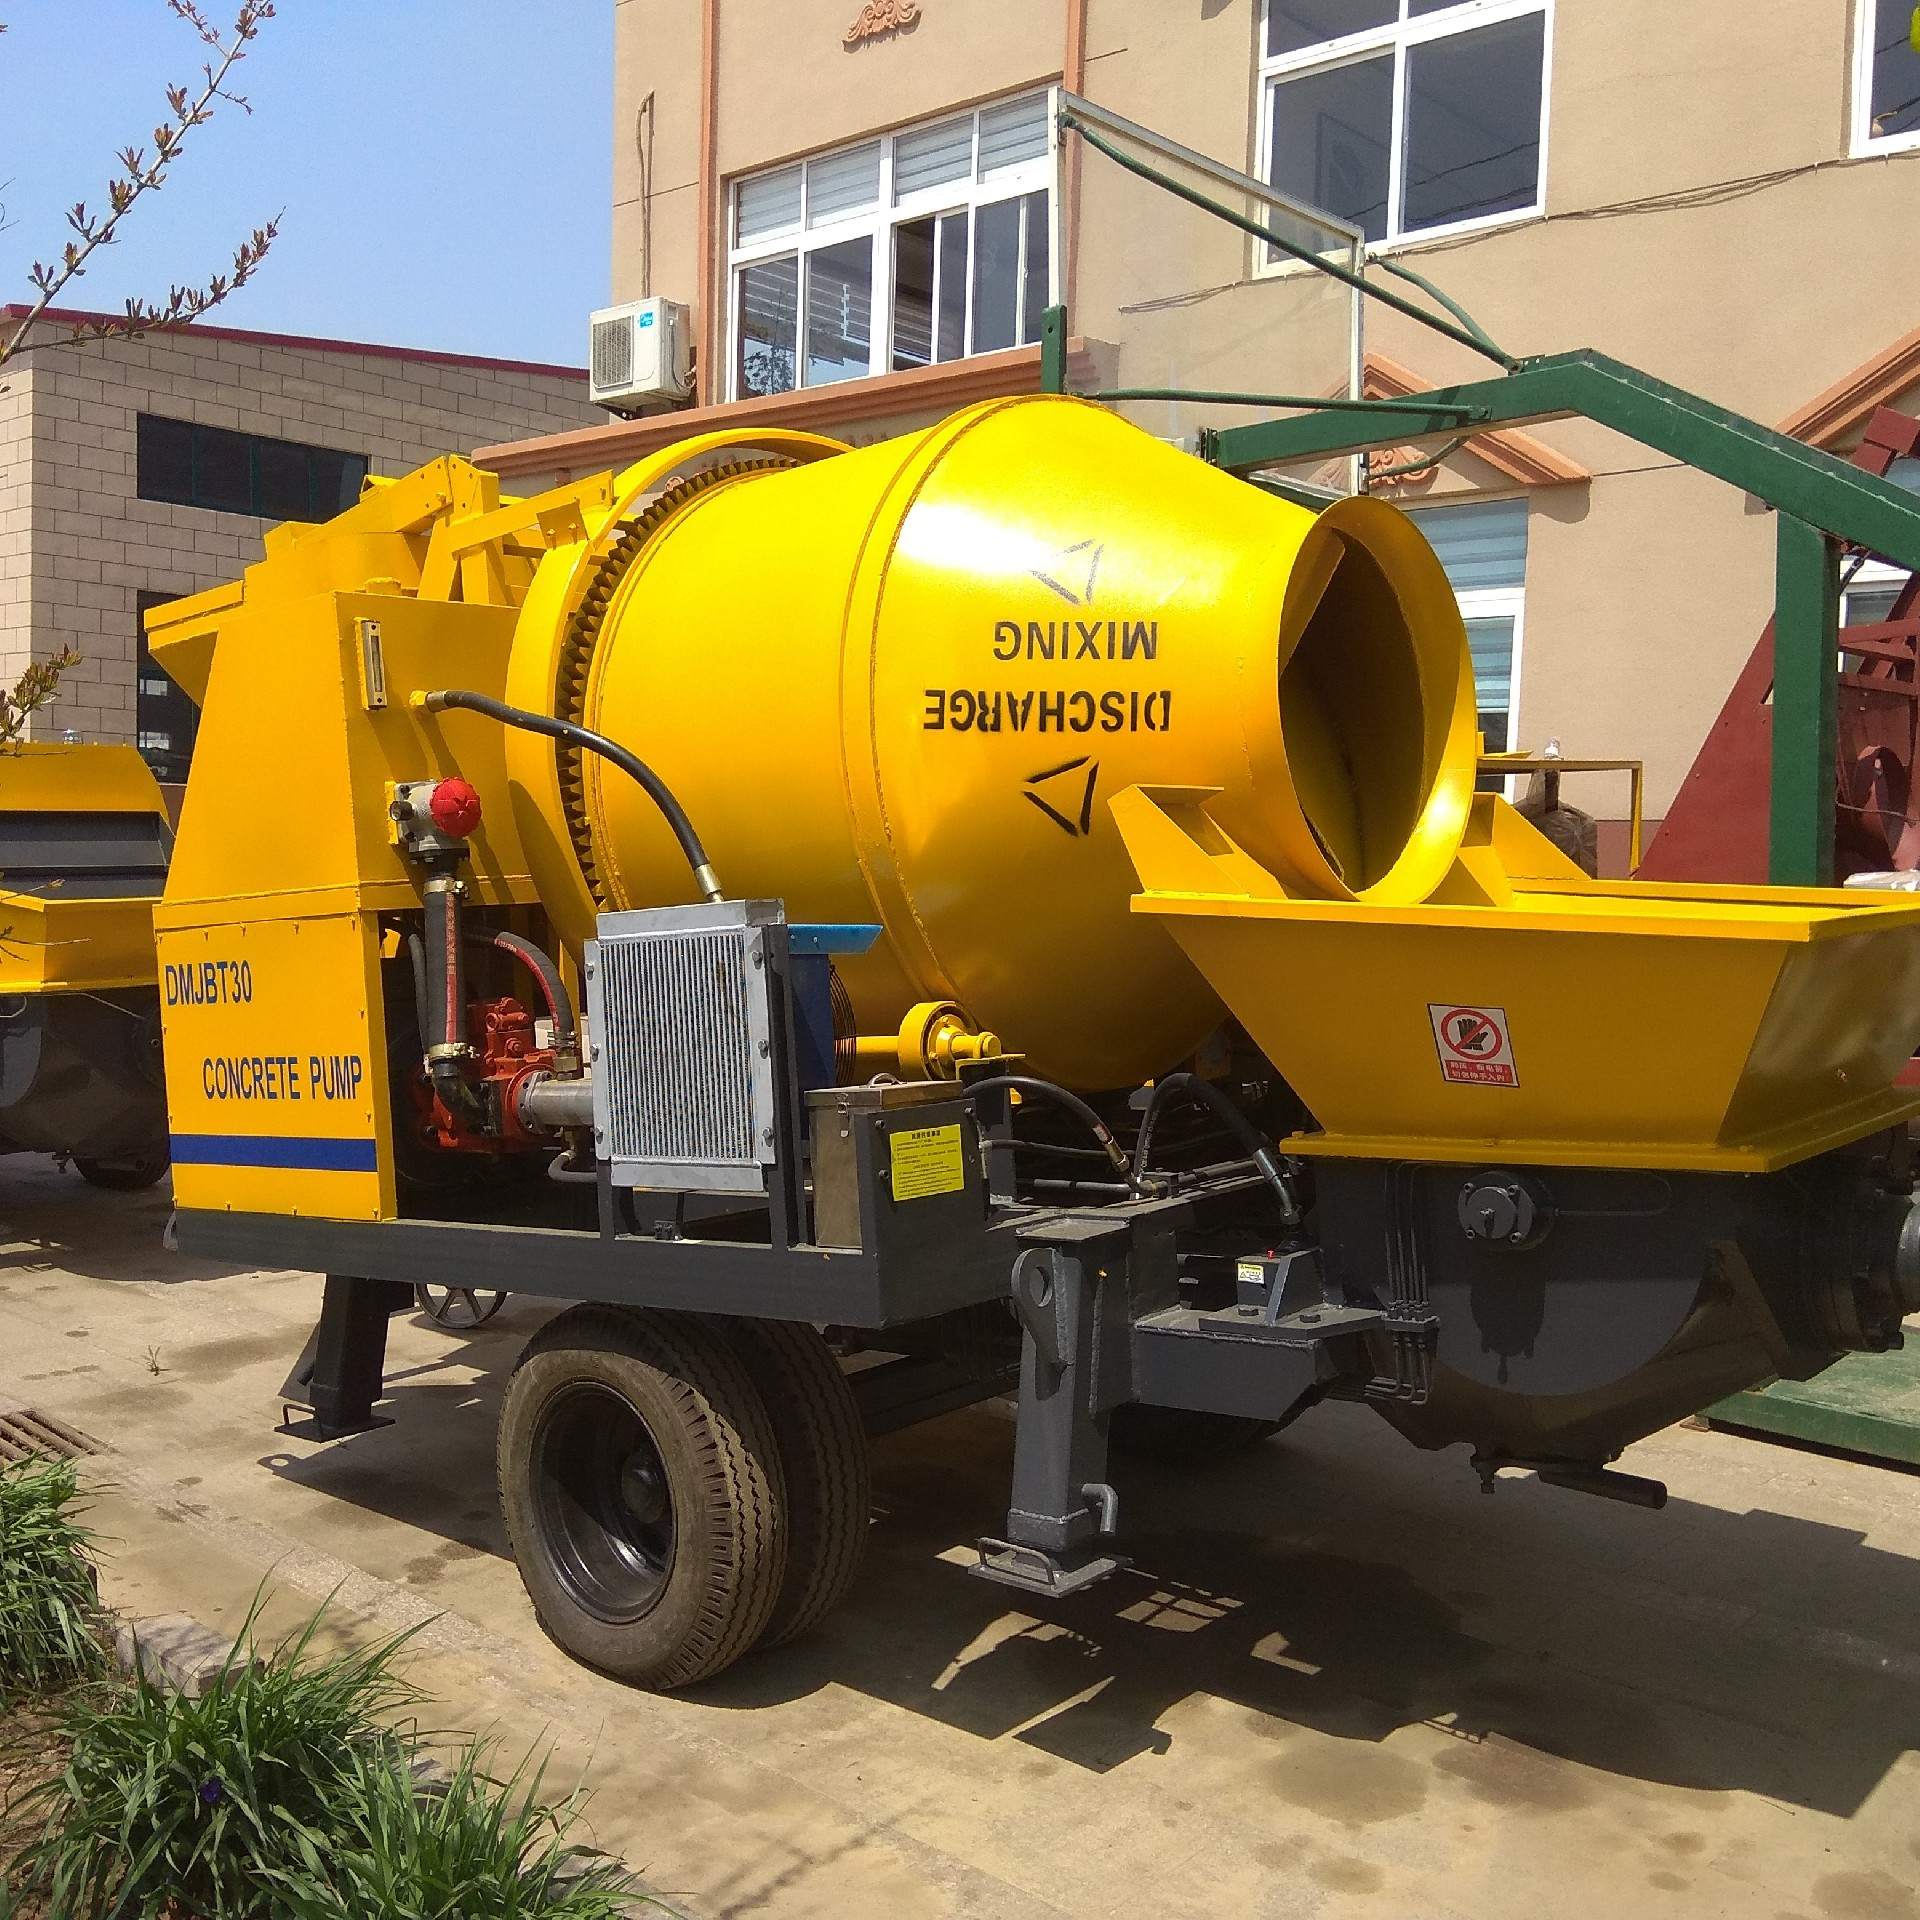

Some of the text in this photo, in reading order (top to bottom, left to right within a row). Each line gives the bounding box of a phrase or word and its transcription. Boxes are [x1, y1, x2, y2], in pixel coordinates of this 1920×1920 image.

[993, 621, 1158, 661] MIXING
[923, 689, 1172, 733] DISCHARGE
[165, 960, 252, 1006] DMJBT30
[202, 1055, 362, 1100] CONCRETE PUMP
